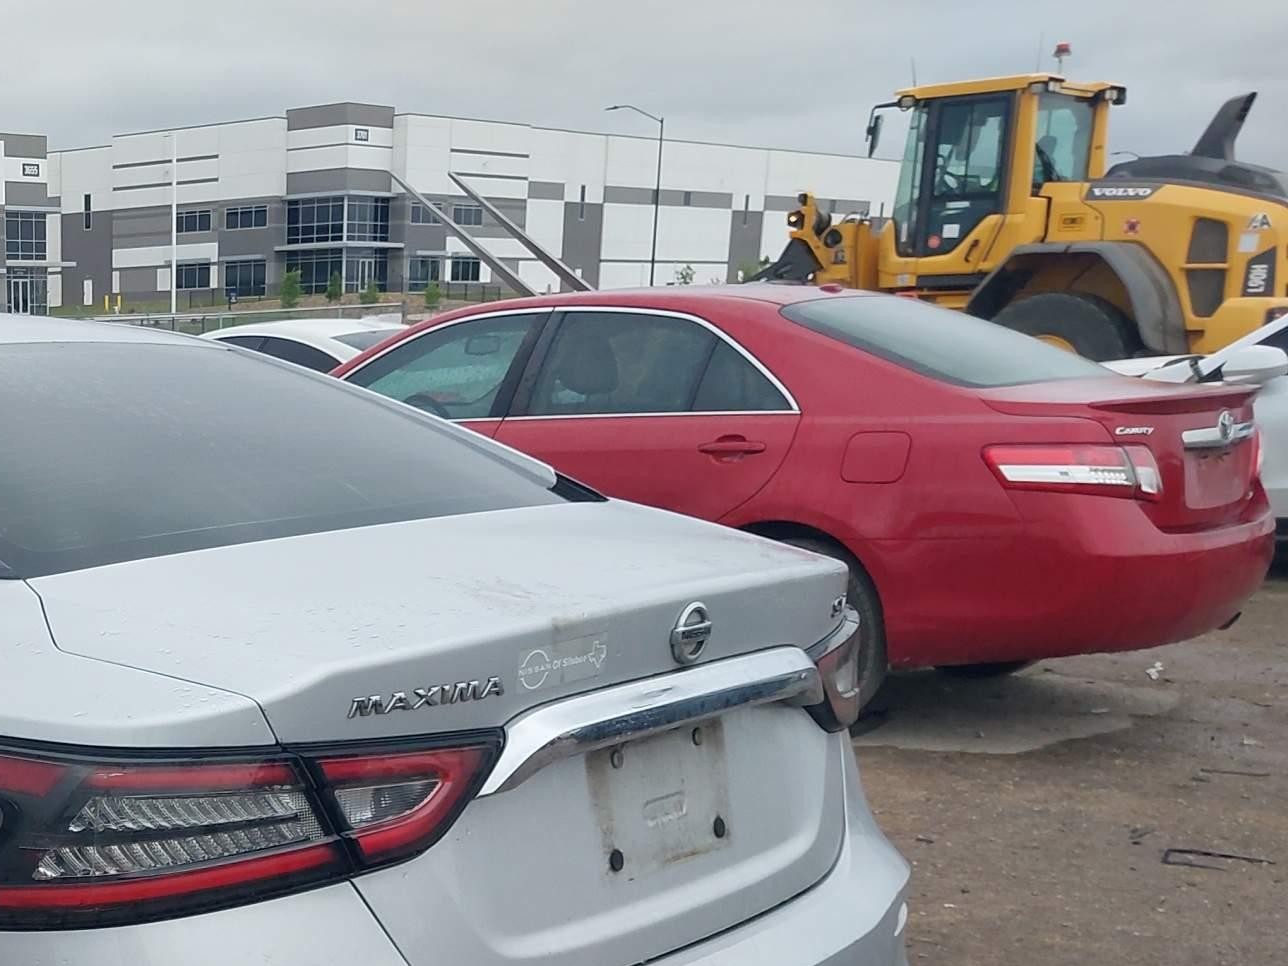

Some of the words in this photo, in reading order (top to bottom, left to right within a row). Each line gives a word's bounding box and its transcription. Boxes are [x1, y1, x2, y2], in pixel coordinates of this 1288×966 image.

[1092, 187, 1152, 197] VOLVO
[1246, 264, 1269, 293] L90H
[518, 662, 552, 677] NISSAN
[346, 675, 505, 719] MAXIMA
